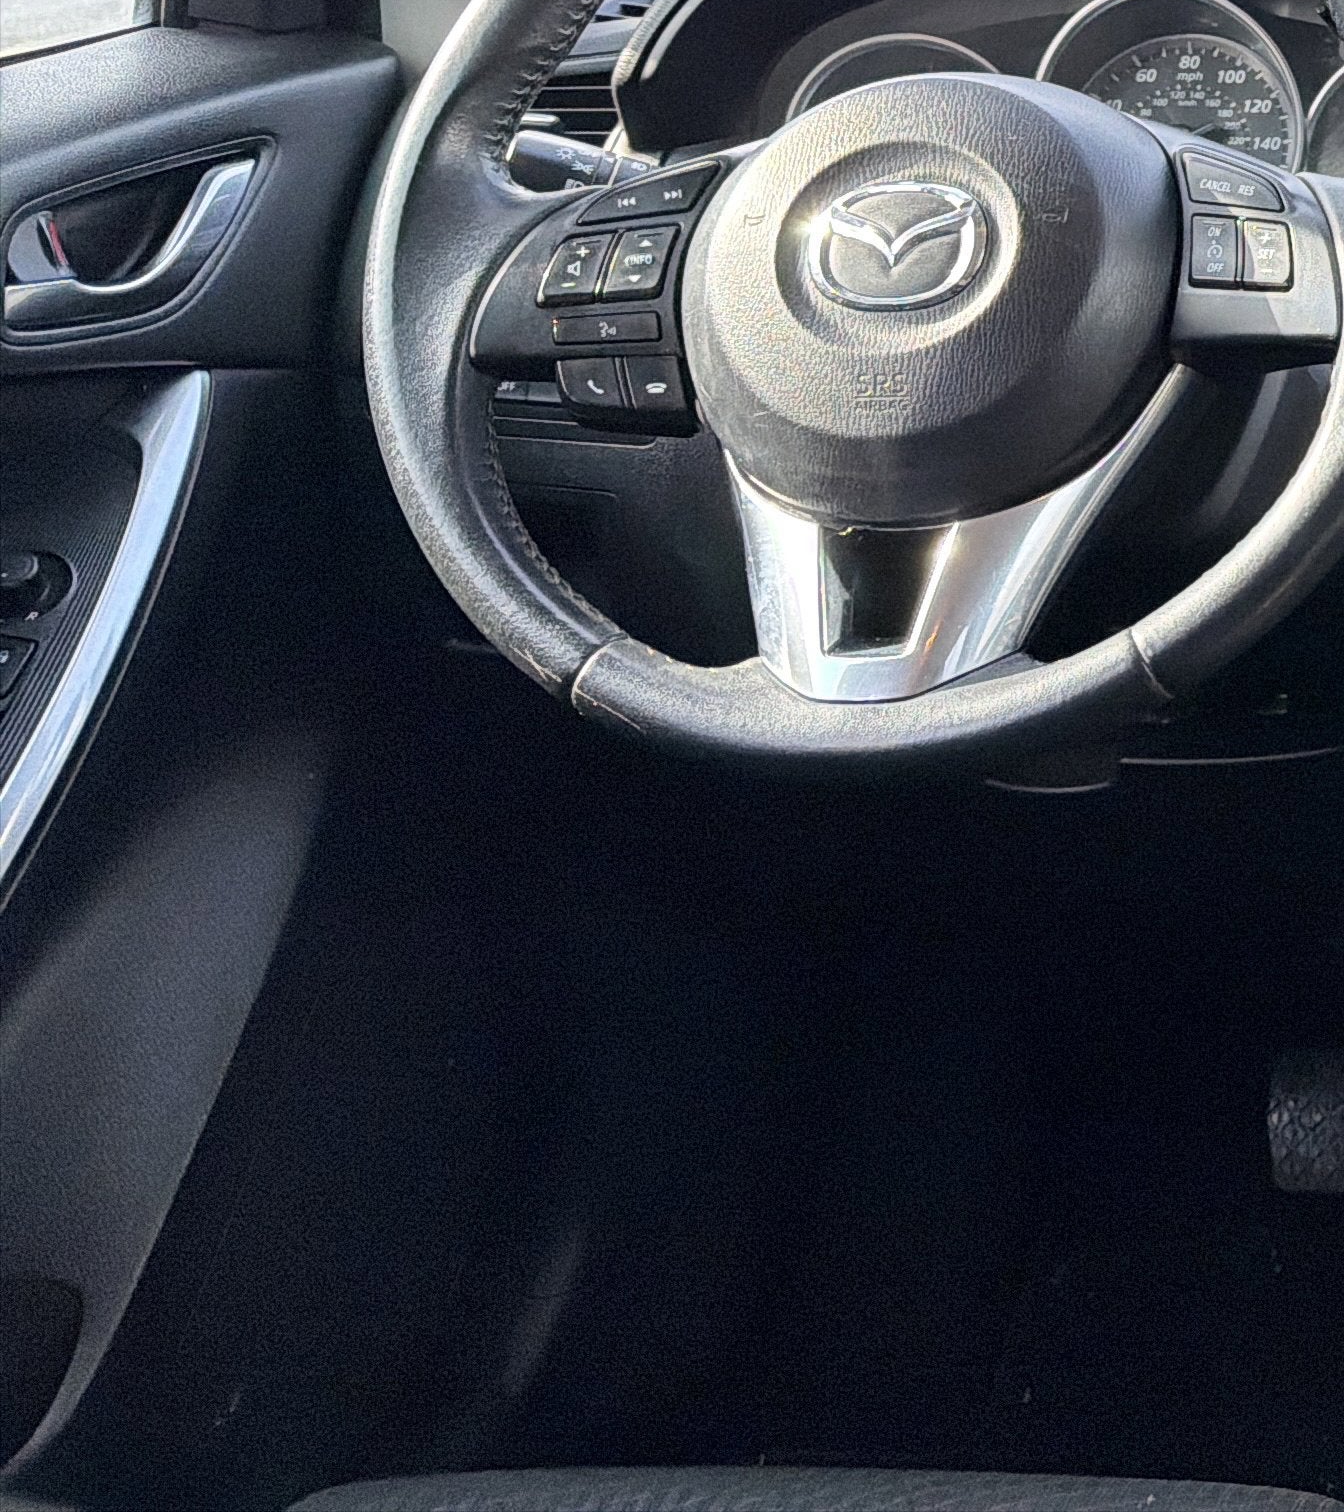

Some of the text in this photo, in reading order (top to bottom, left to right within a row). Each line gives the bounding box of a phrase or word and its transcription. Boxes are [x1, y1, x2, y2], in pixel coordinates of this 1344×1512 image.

[1178, 56, 1201, 69] 80
[1135, 68, 1157, 82] 60
[1177, 72, 1203, 82] mph
[1218, 70, 1246, 83] 100
[1243, 99, 1272, 113] 120
[1253, 136, 1281, 150] 140
[1200, 178, 1255, 196] CANCEL RES
[1208, 226, 1222, 238] ON
[1258, 248, 1275, 260] SET
[1206, 262, 1225, 273] OFF
[25, 610, 38, 622] R
